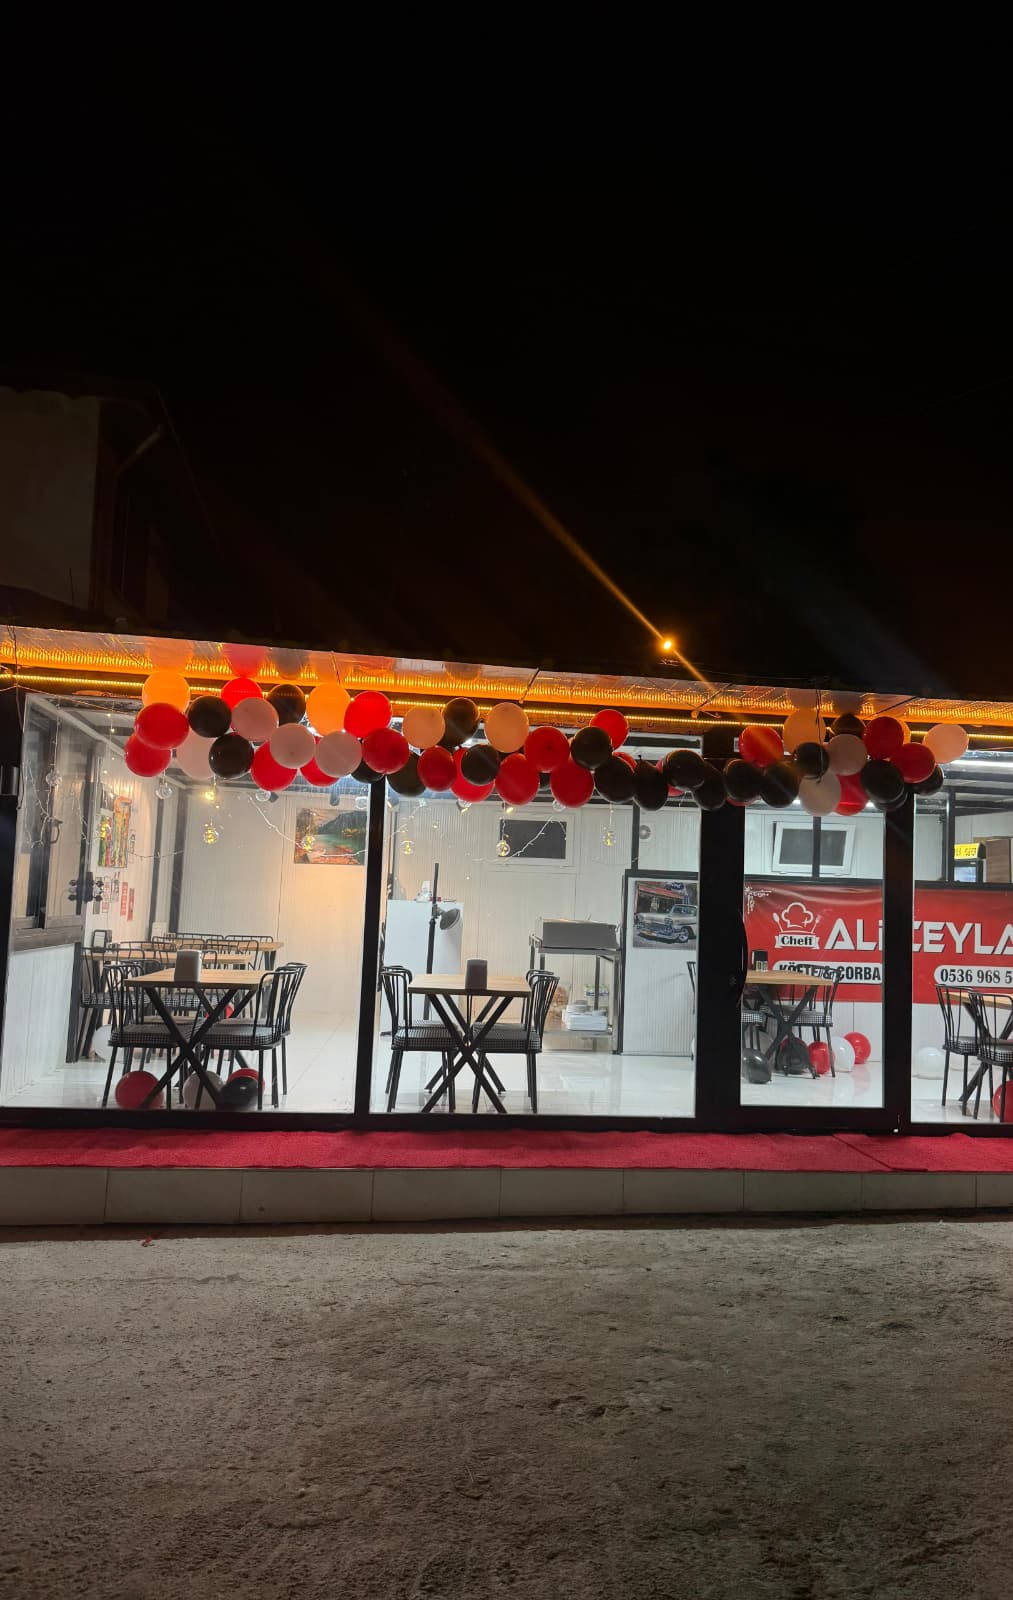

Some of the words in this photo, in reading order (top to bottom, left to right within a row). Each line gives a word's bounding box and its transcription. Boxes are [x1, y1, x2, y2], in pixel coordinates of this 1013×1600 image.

[940, 968, 973, 983] 0536
[977, 969, 1001, 984] 968
[1005, 970, 1013, 984] 5
